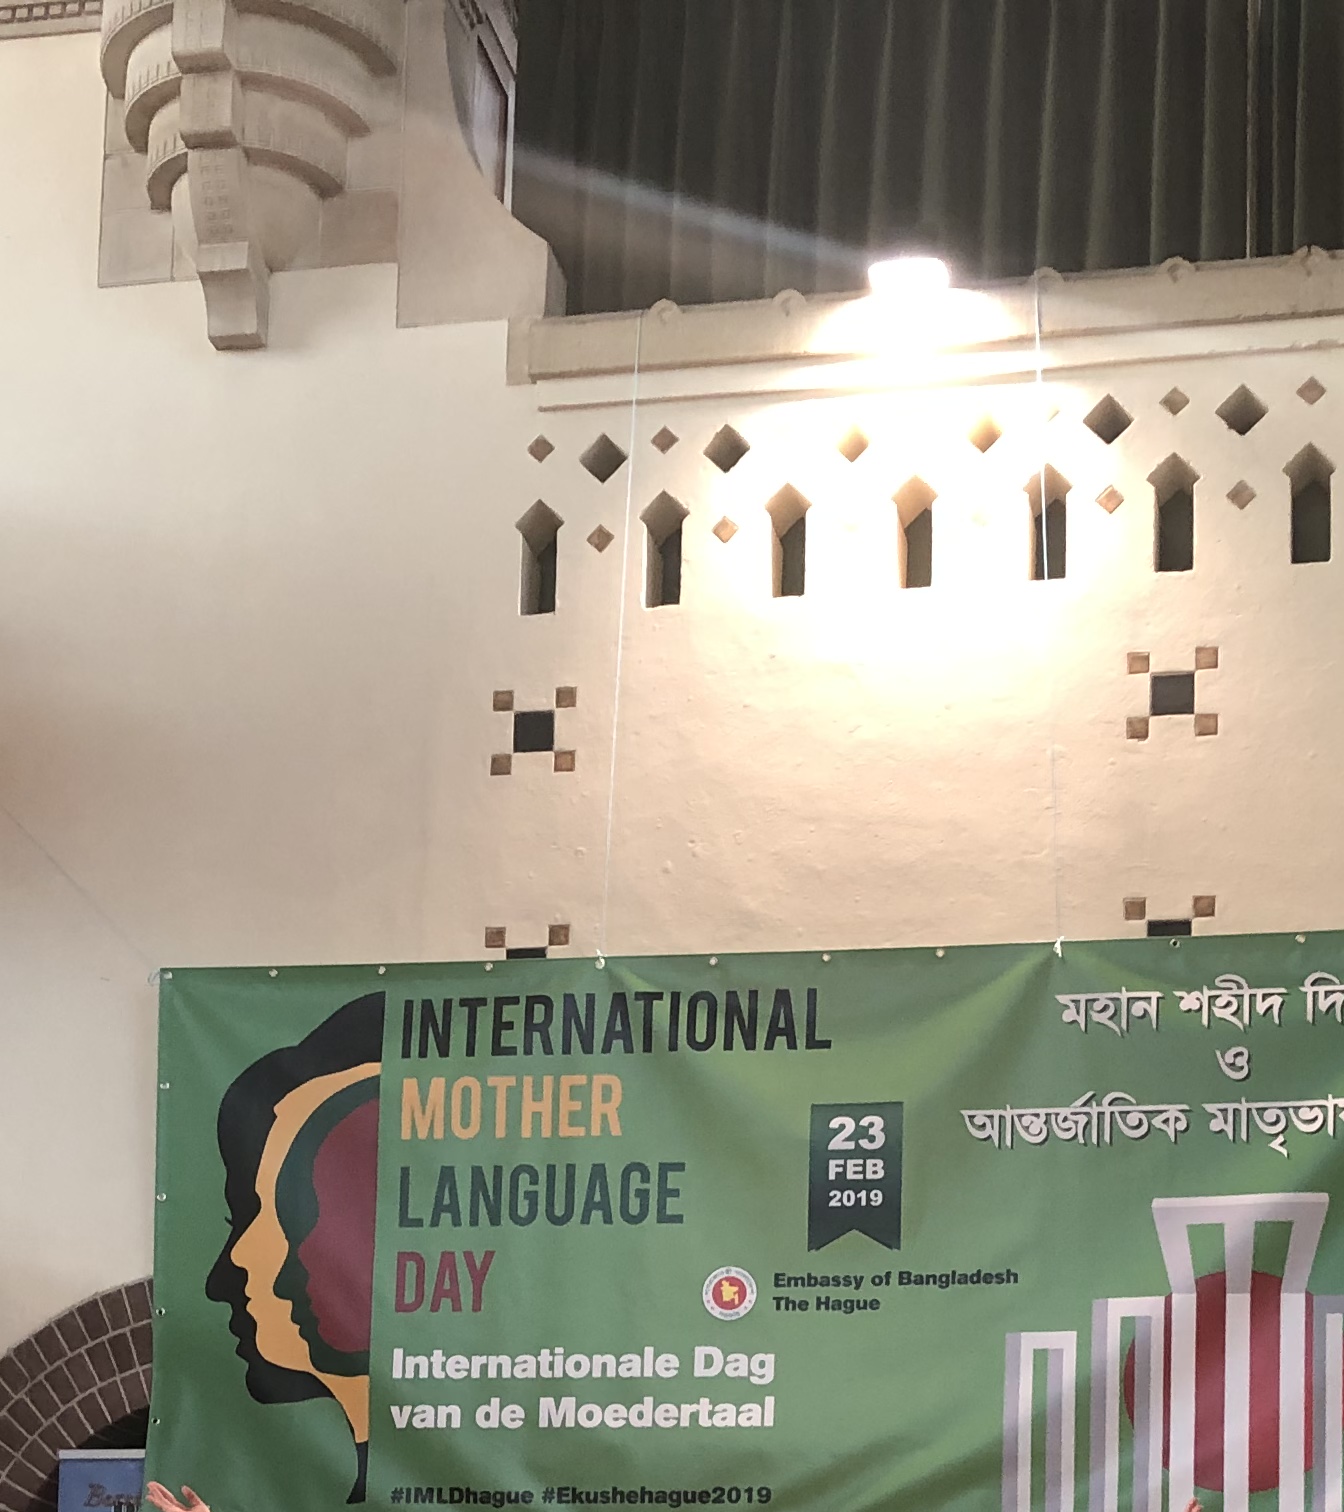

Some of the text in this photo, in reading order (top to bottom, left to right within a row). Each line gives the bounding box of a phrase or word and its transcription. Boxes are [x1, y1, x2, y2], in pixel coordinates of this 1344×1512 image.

[1056, 986, 1165, 1036] মহান
[1172, 973, 1288, 1032] শহীদ
[400, 987, 832, 1059] INTERNATIONAL
[1215, 1046, 1251, 1081] ও
[400, 1074, 623, 1140] MOTHER
[960, 1090, 1190, 1150] আন্তর্জাতিক
[827, 1115, 886, 1150] 23
[828, 1159, 885, 1181] FEB
[398, 1161, 686, 1228] LANGUAGE
[828, 1189, 883, 1207] 2019
[394, 1250, 496, 1313] DAY
[773, 1269, 1019, 1290] Embassy of Bangladesh
[772, 1296, 881, 1314] The Hague
[391, 1346, 775, 1385] Internationale Dag
[390, 1396, 775, 1429] van de Moedertaal
[390, 1486, 772, 1508] #IMLDhague #Ekushehague2019
